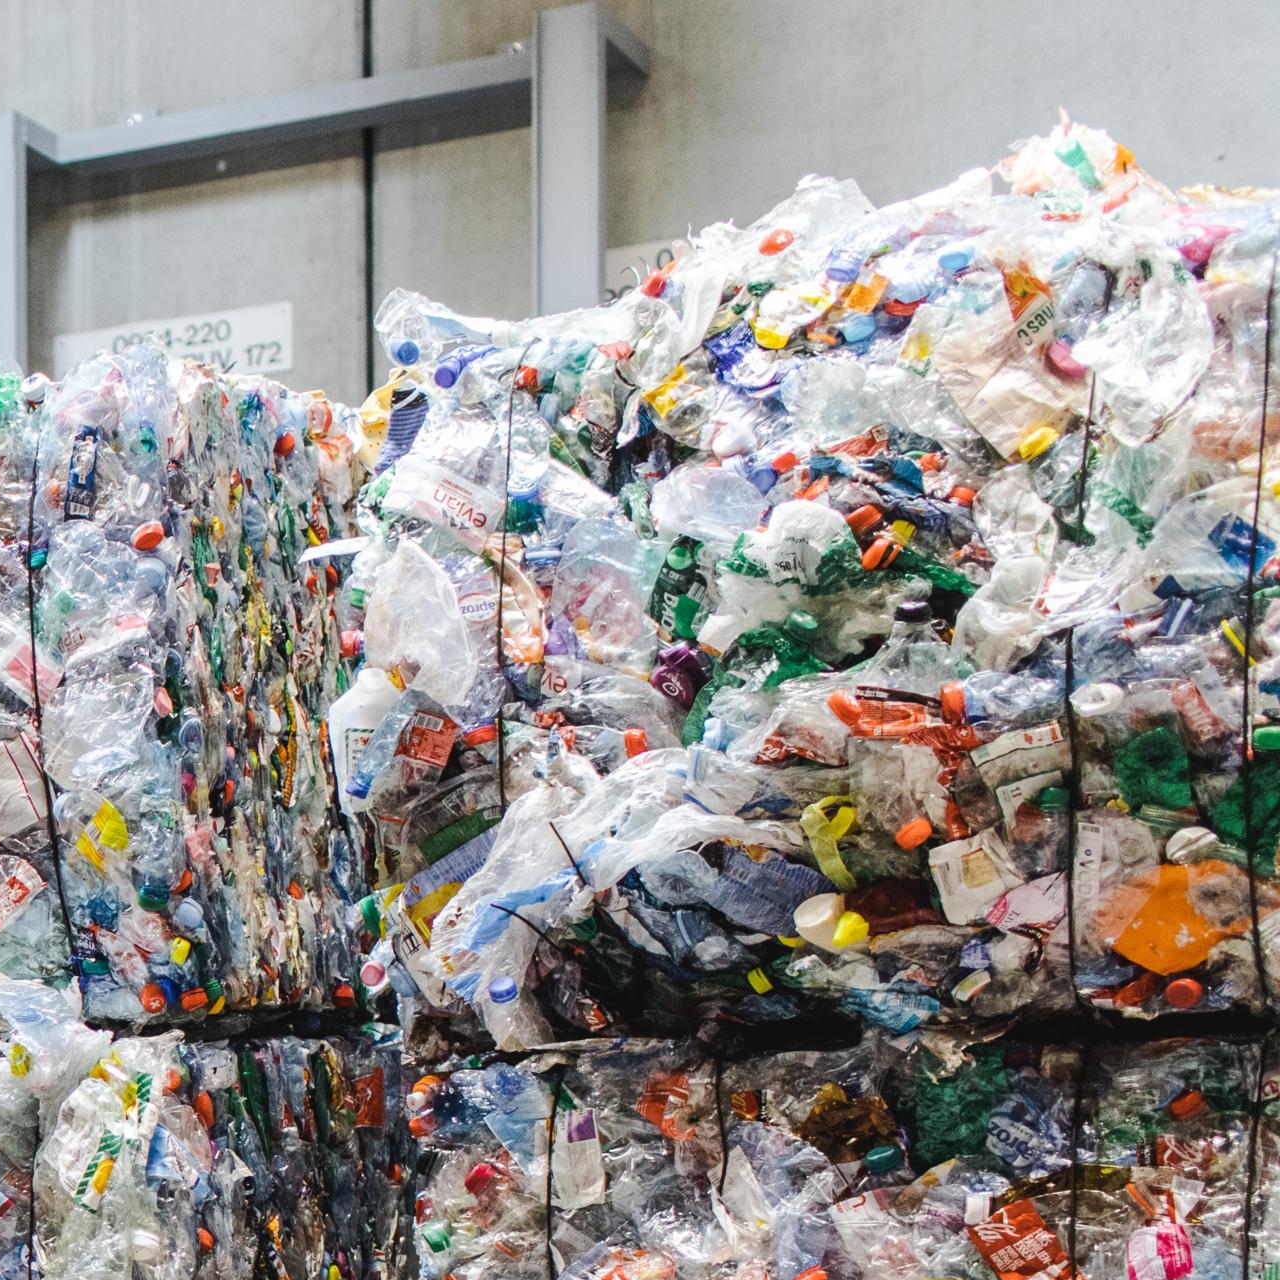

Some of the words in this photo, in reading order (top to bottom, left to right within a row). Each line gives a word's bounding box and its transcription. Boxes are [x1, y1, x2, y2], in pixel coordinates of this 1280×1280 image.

[246, 340, 282, 365] 172
[433, 486, 489, 529] evian
[460, 601, 496, 615] aproz
